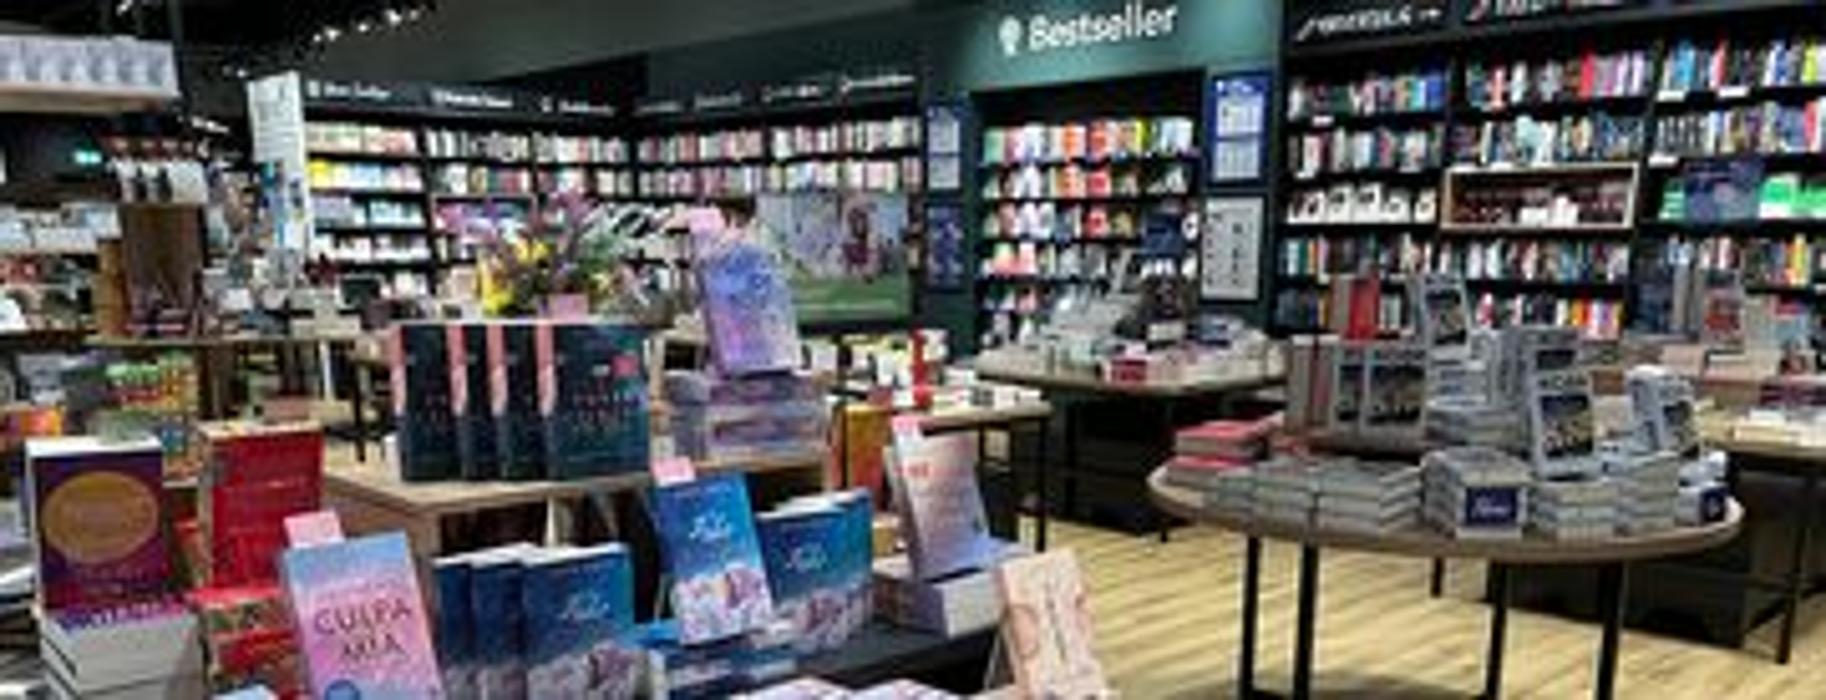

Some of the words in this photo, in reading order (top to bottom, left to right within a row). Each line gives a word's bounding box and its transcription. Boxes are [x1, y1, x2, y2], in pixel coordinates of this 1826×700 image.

[1029, 1, 1178, 51] Bestseller
[315, 597, 412, 636] CULPA
[340, 632, 408, 661] MIA
